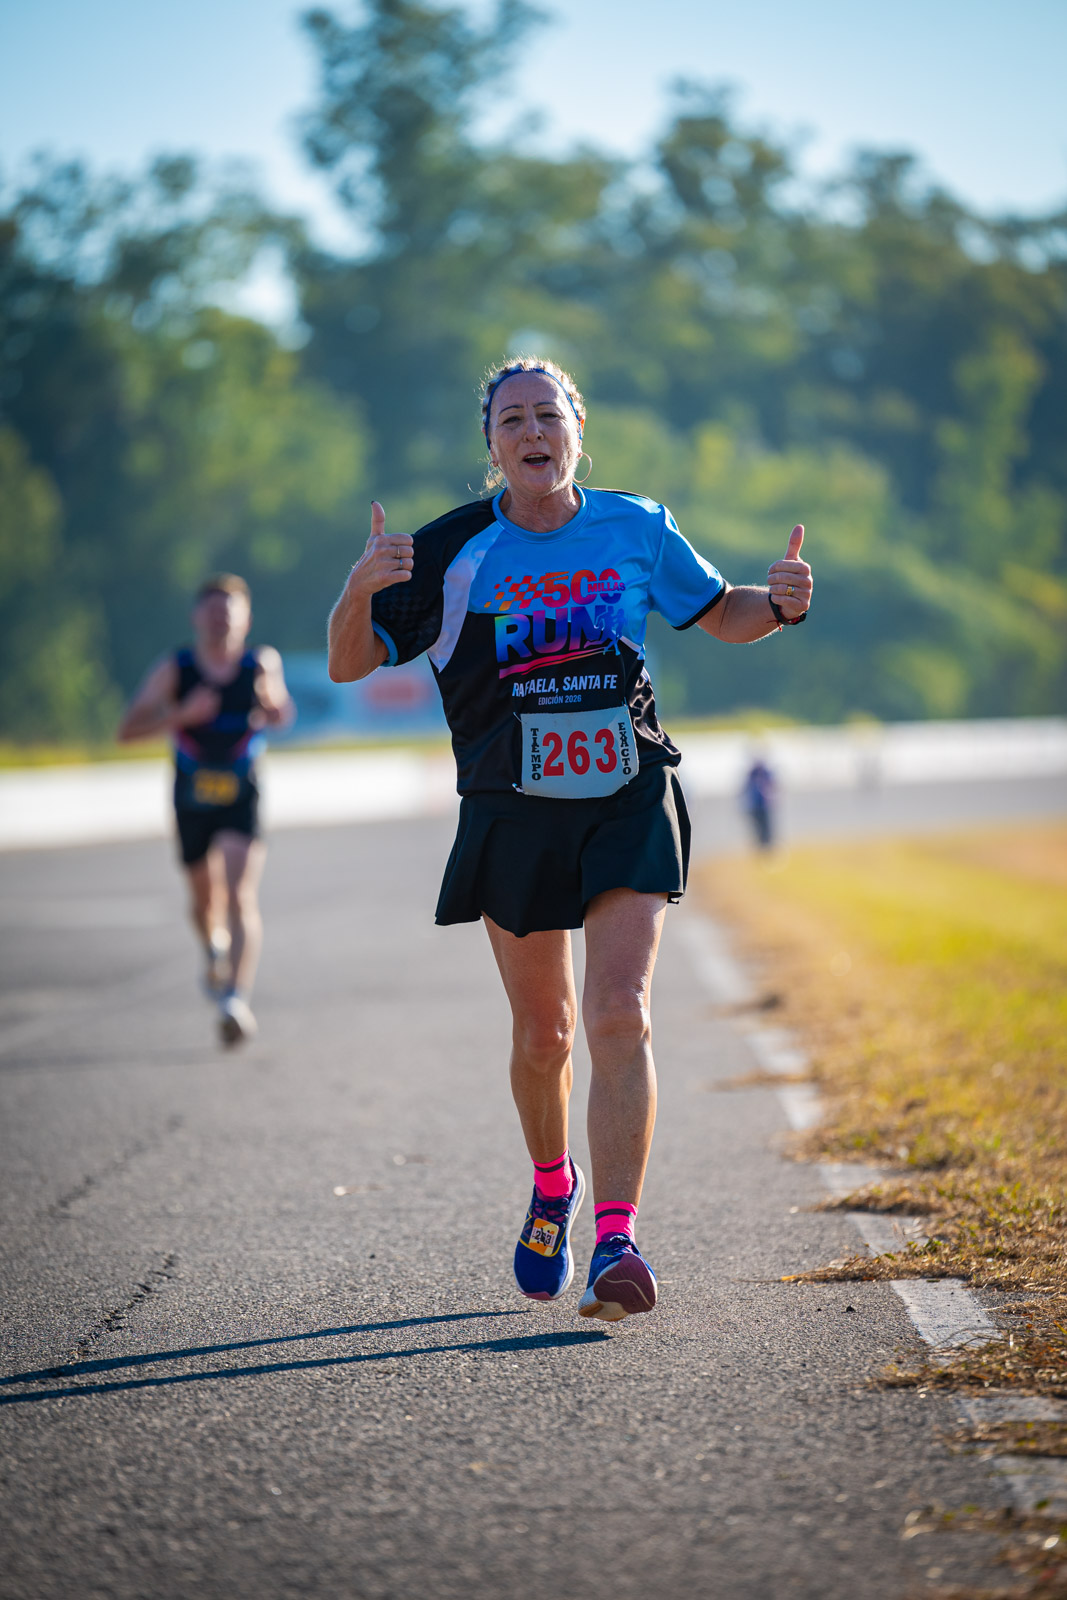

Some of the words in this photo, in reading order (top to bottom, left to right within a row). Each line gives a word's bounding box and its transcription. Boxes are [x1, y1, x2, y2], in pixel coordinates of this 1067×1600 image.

[542, 568, 621, 608] 500
[587, 582, 626, 593] MILLAS
[494, 605, 612, 662] RUN
[512, 679, 559, 697] RAFAELA,
[562, 675, 601, 691] SANTA
[603, 675, 618, 689] FE
[538, 694, 563, 706] EDICIÓN
[565, 694, 582, 704] 2026
[530, 728, 541, 781] TIEMPO
[542, 728, 617, 776] 263
[617, 722, 632, 775] EXACTO
